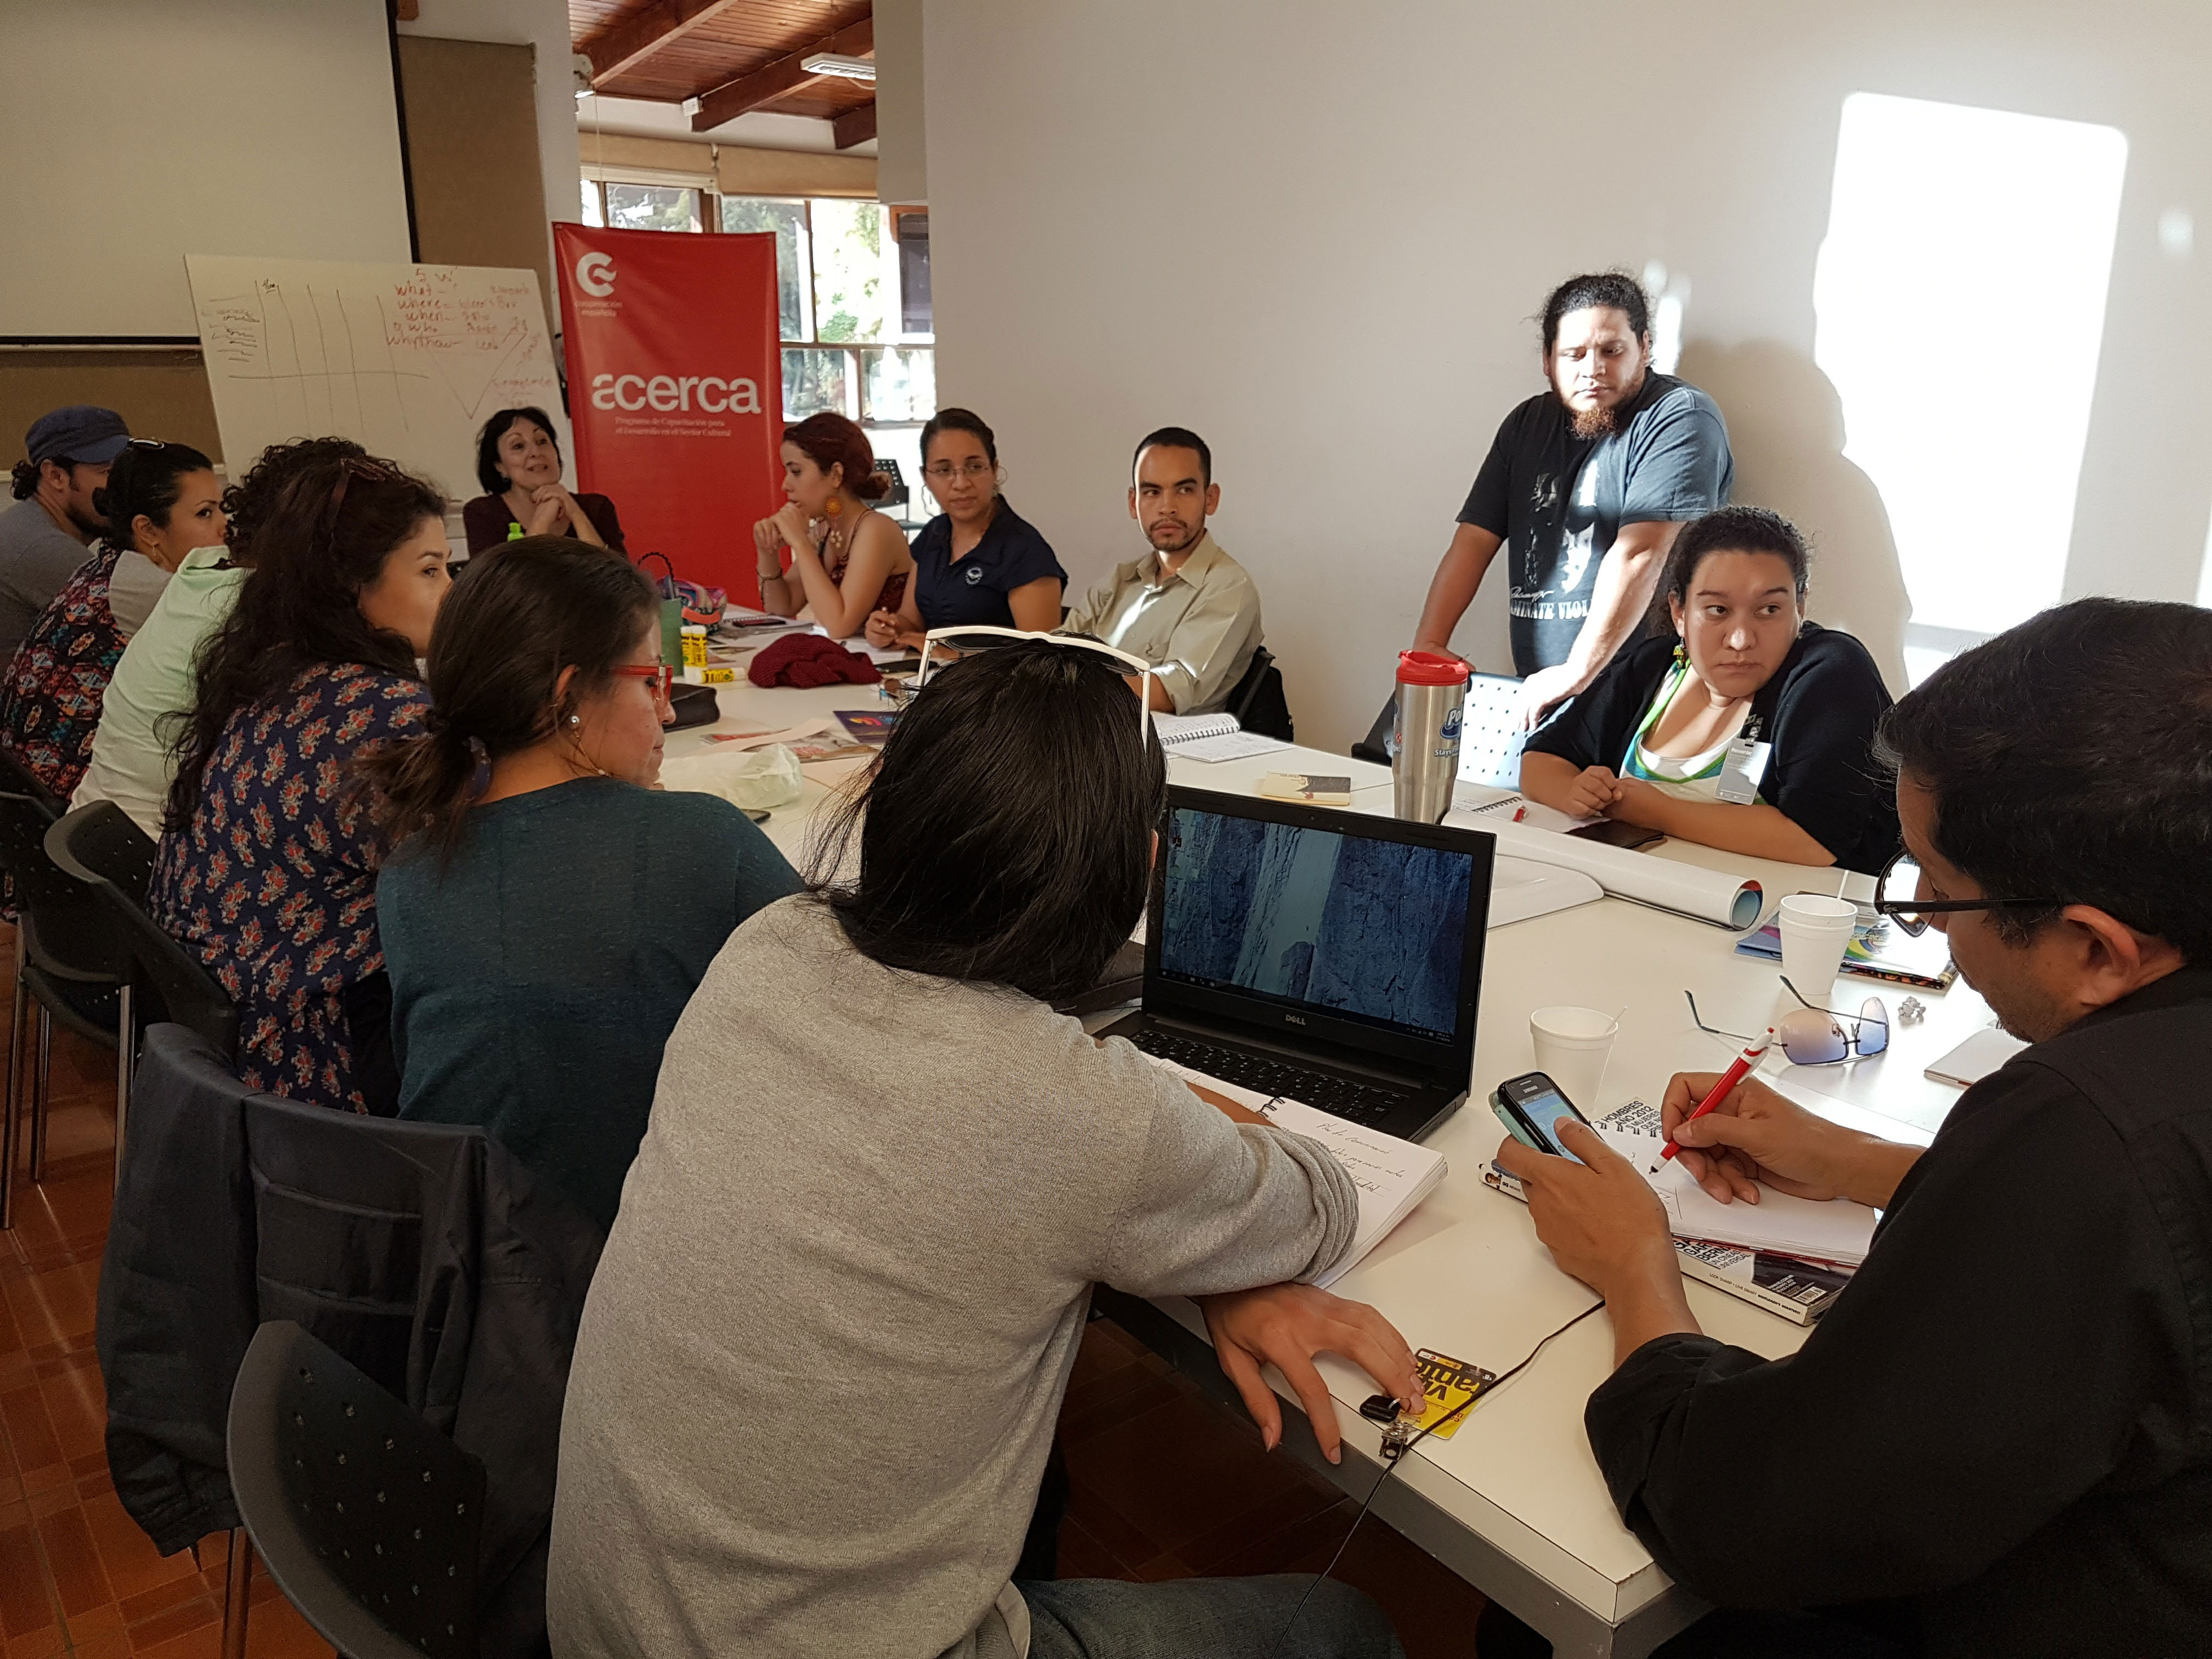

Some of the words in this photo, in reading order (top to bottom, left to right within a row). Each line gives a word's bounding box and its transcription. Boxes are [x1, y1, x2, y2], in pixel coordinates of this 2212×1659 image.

[591, 373, 762, 415] acerca
[1434, 748, 1452, 757] Stays
[1285, 1014, 1306, 1025] DELL
[1601, 1101, 1644, 1123] HOMBRES
[1632, 1105, 1655, 1118] 2012
